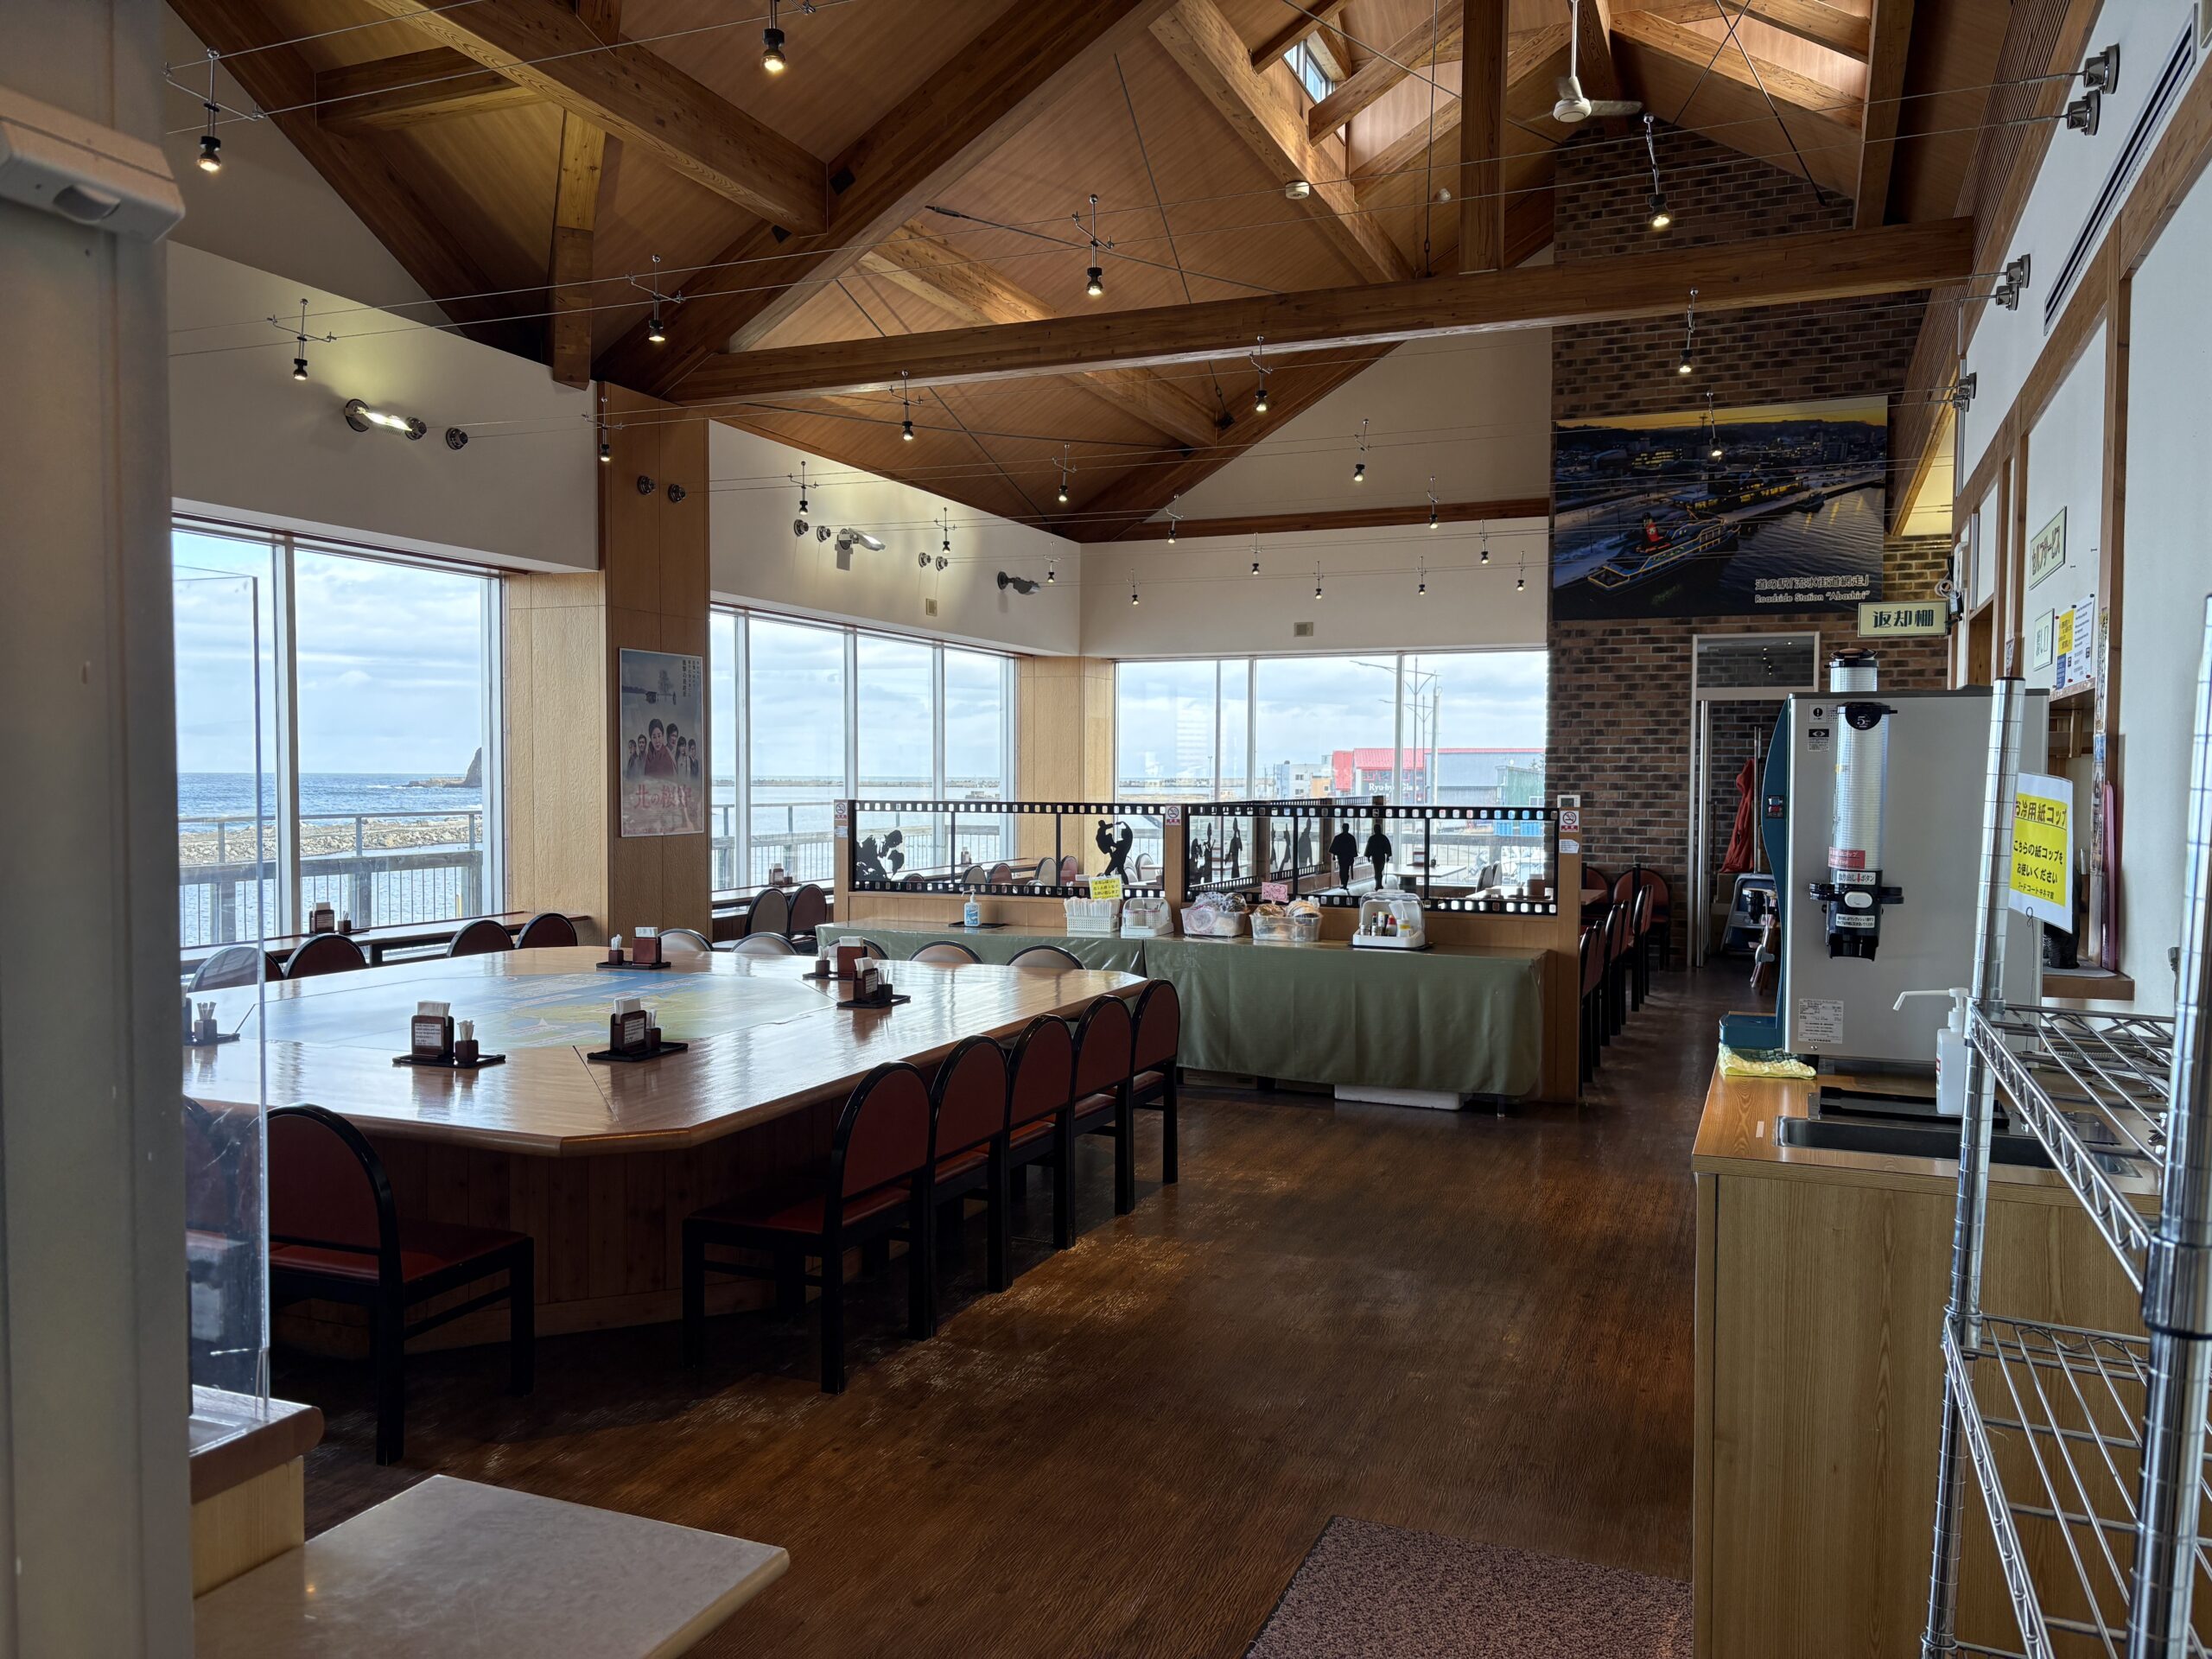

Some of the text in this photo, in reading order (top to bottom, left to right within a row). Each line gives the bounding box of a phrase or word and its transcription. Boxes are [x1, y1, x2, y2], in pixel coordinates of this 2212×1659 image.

[1755, 594, 1793, 603] Roadside
[1795, 593, 1824, 602] Station
[1872, 609, 1934, 628] 返却棚
[2013, 840, 2063, 865] こちらの紙コップを
[2017, 863, 2057, 884] お使いください
